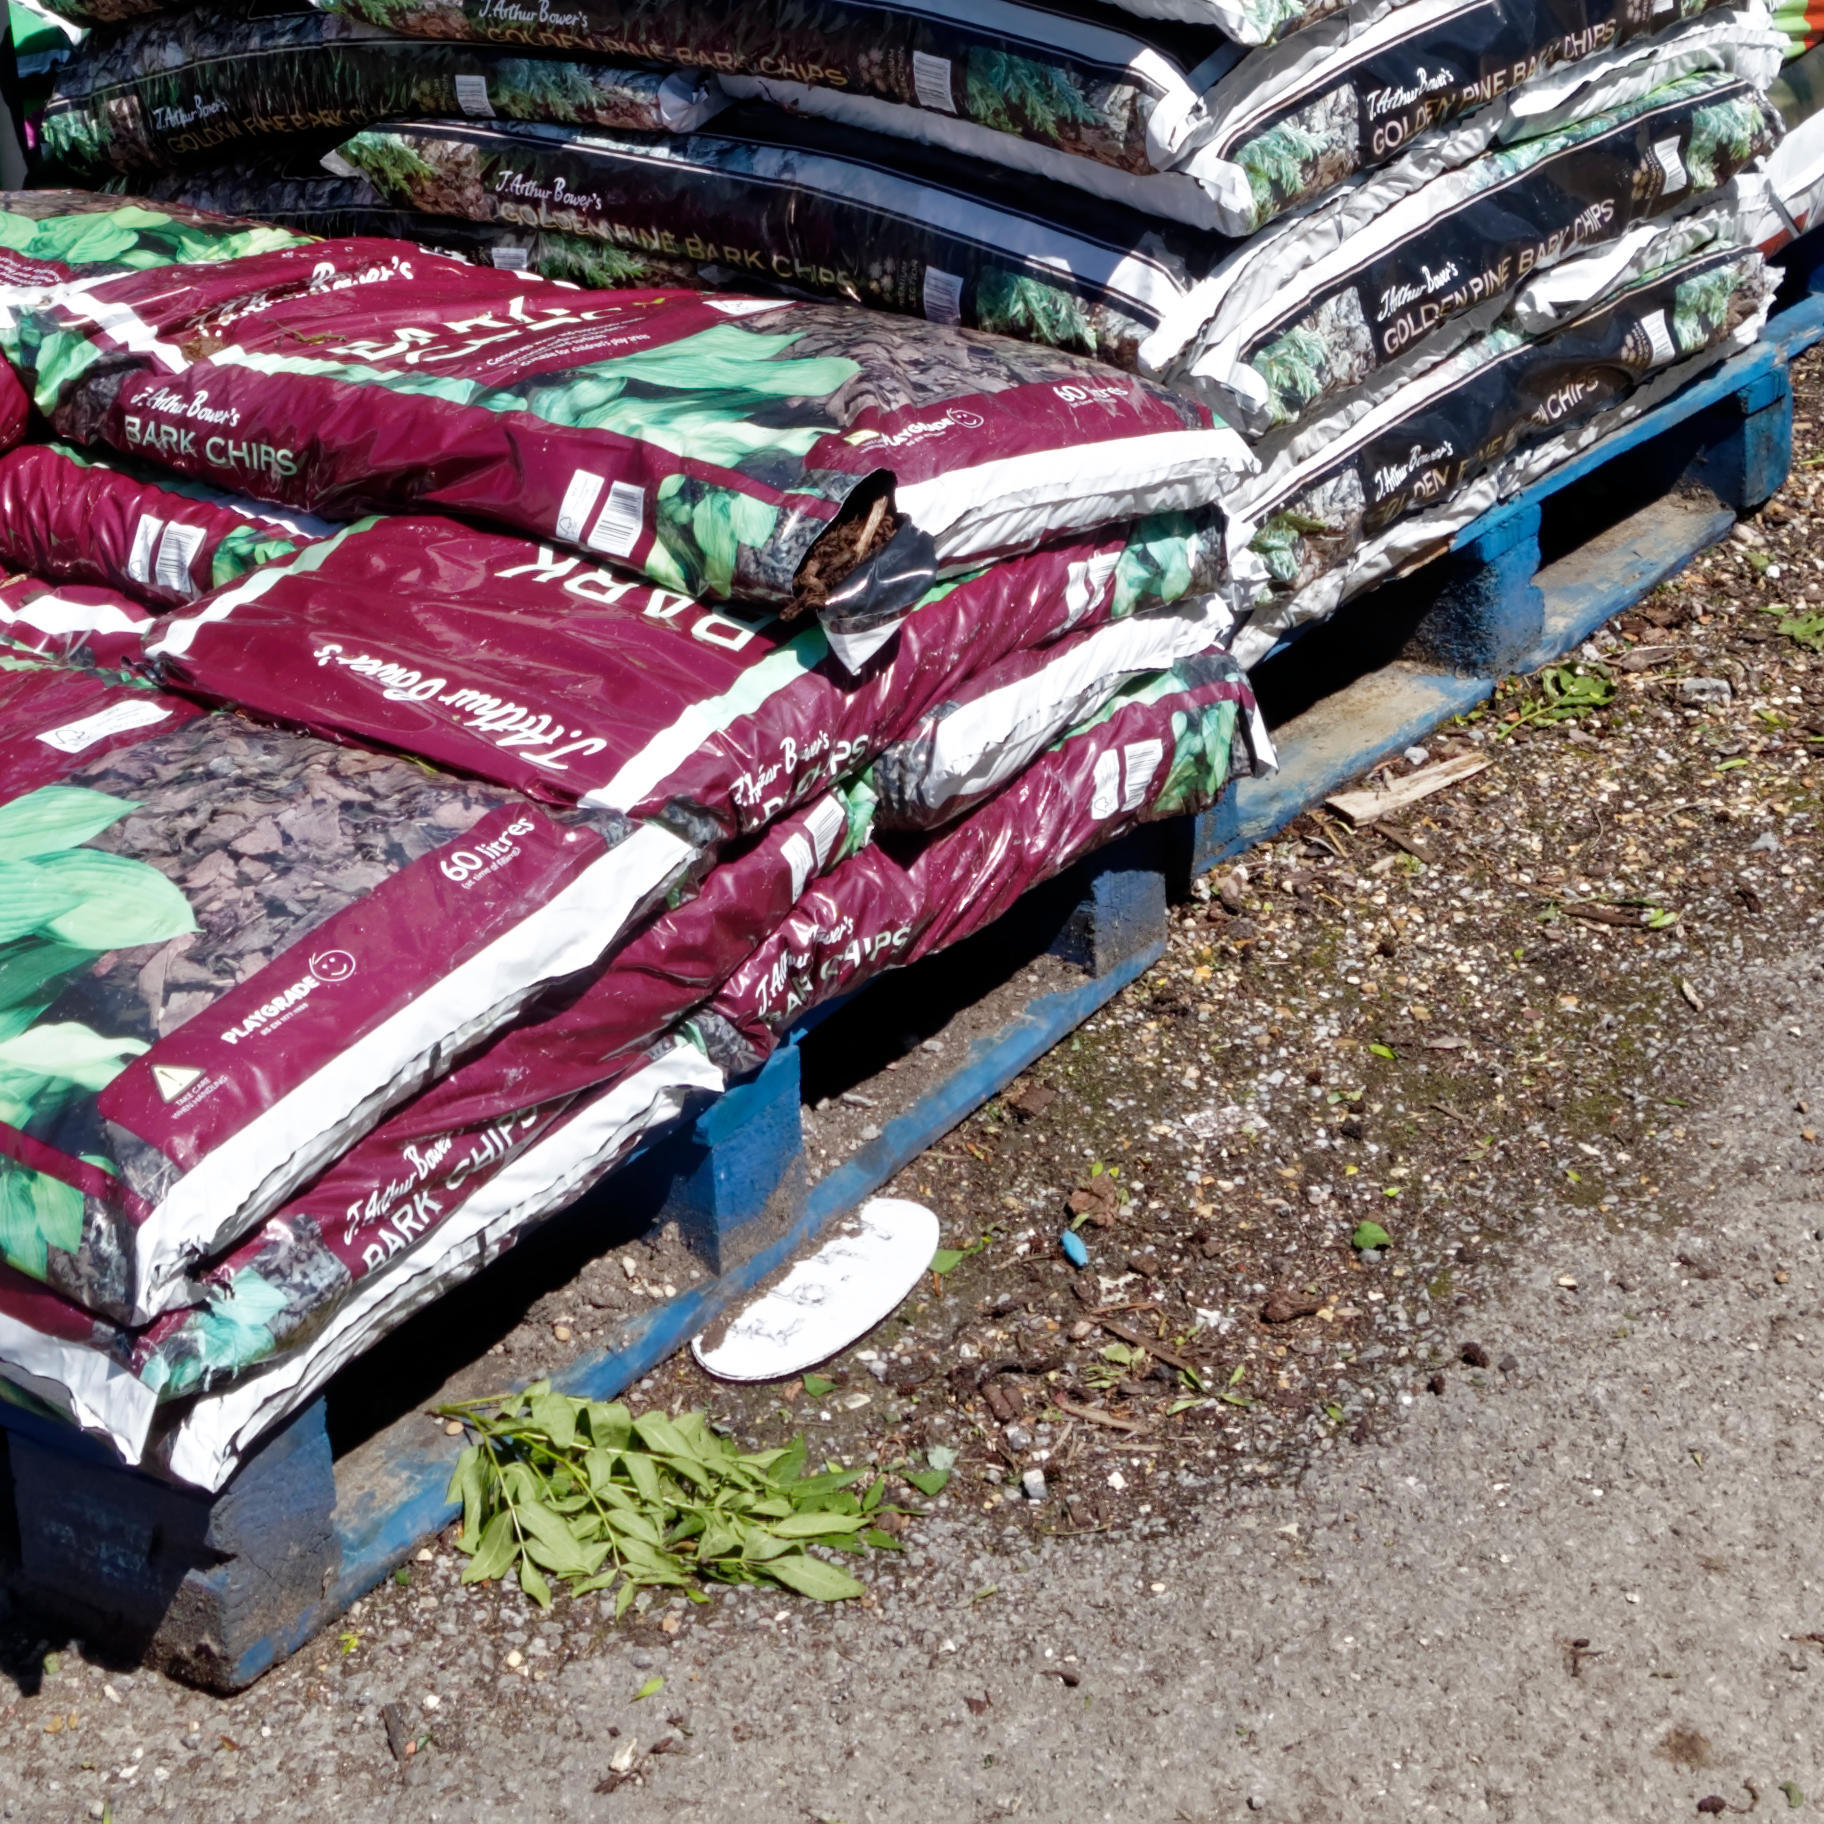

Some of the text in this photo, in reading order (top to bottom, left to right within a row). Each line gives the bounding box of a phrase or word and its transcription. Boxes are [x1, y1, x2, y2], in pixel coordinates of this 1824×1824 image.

[1575, 199, 1616, 244] CHIPS
[1384, 258, 1510, 354] GOLDEN PINE
[187, 390, 240, 426] Bower's
[125, 416, 298, 477] BARK CHIPS
[314, 644, 447, 701] Bower's
[440, 850, 482, 882] 60
[477, 817, 535, 860] litres
[221, 976, 320, 1045] PLAYGRADE
